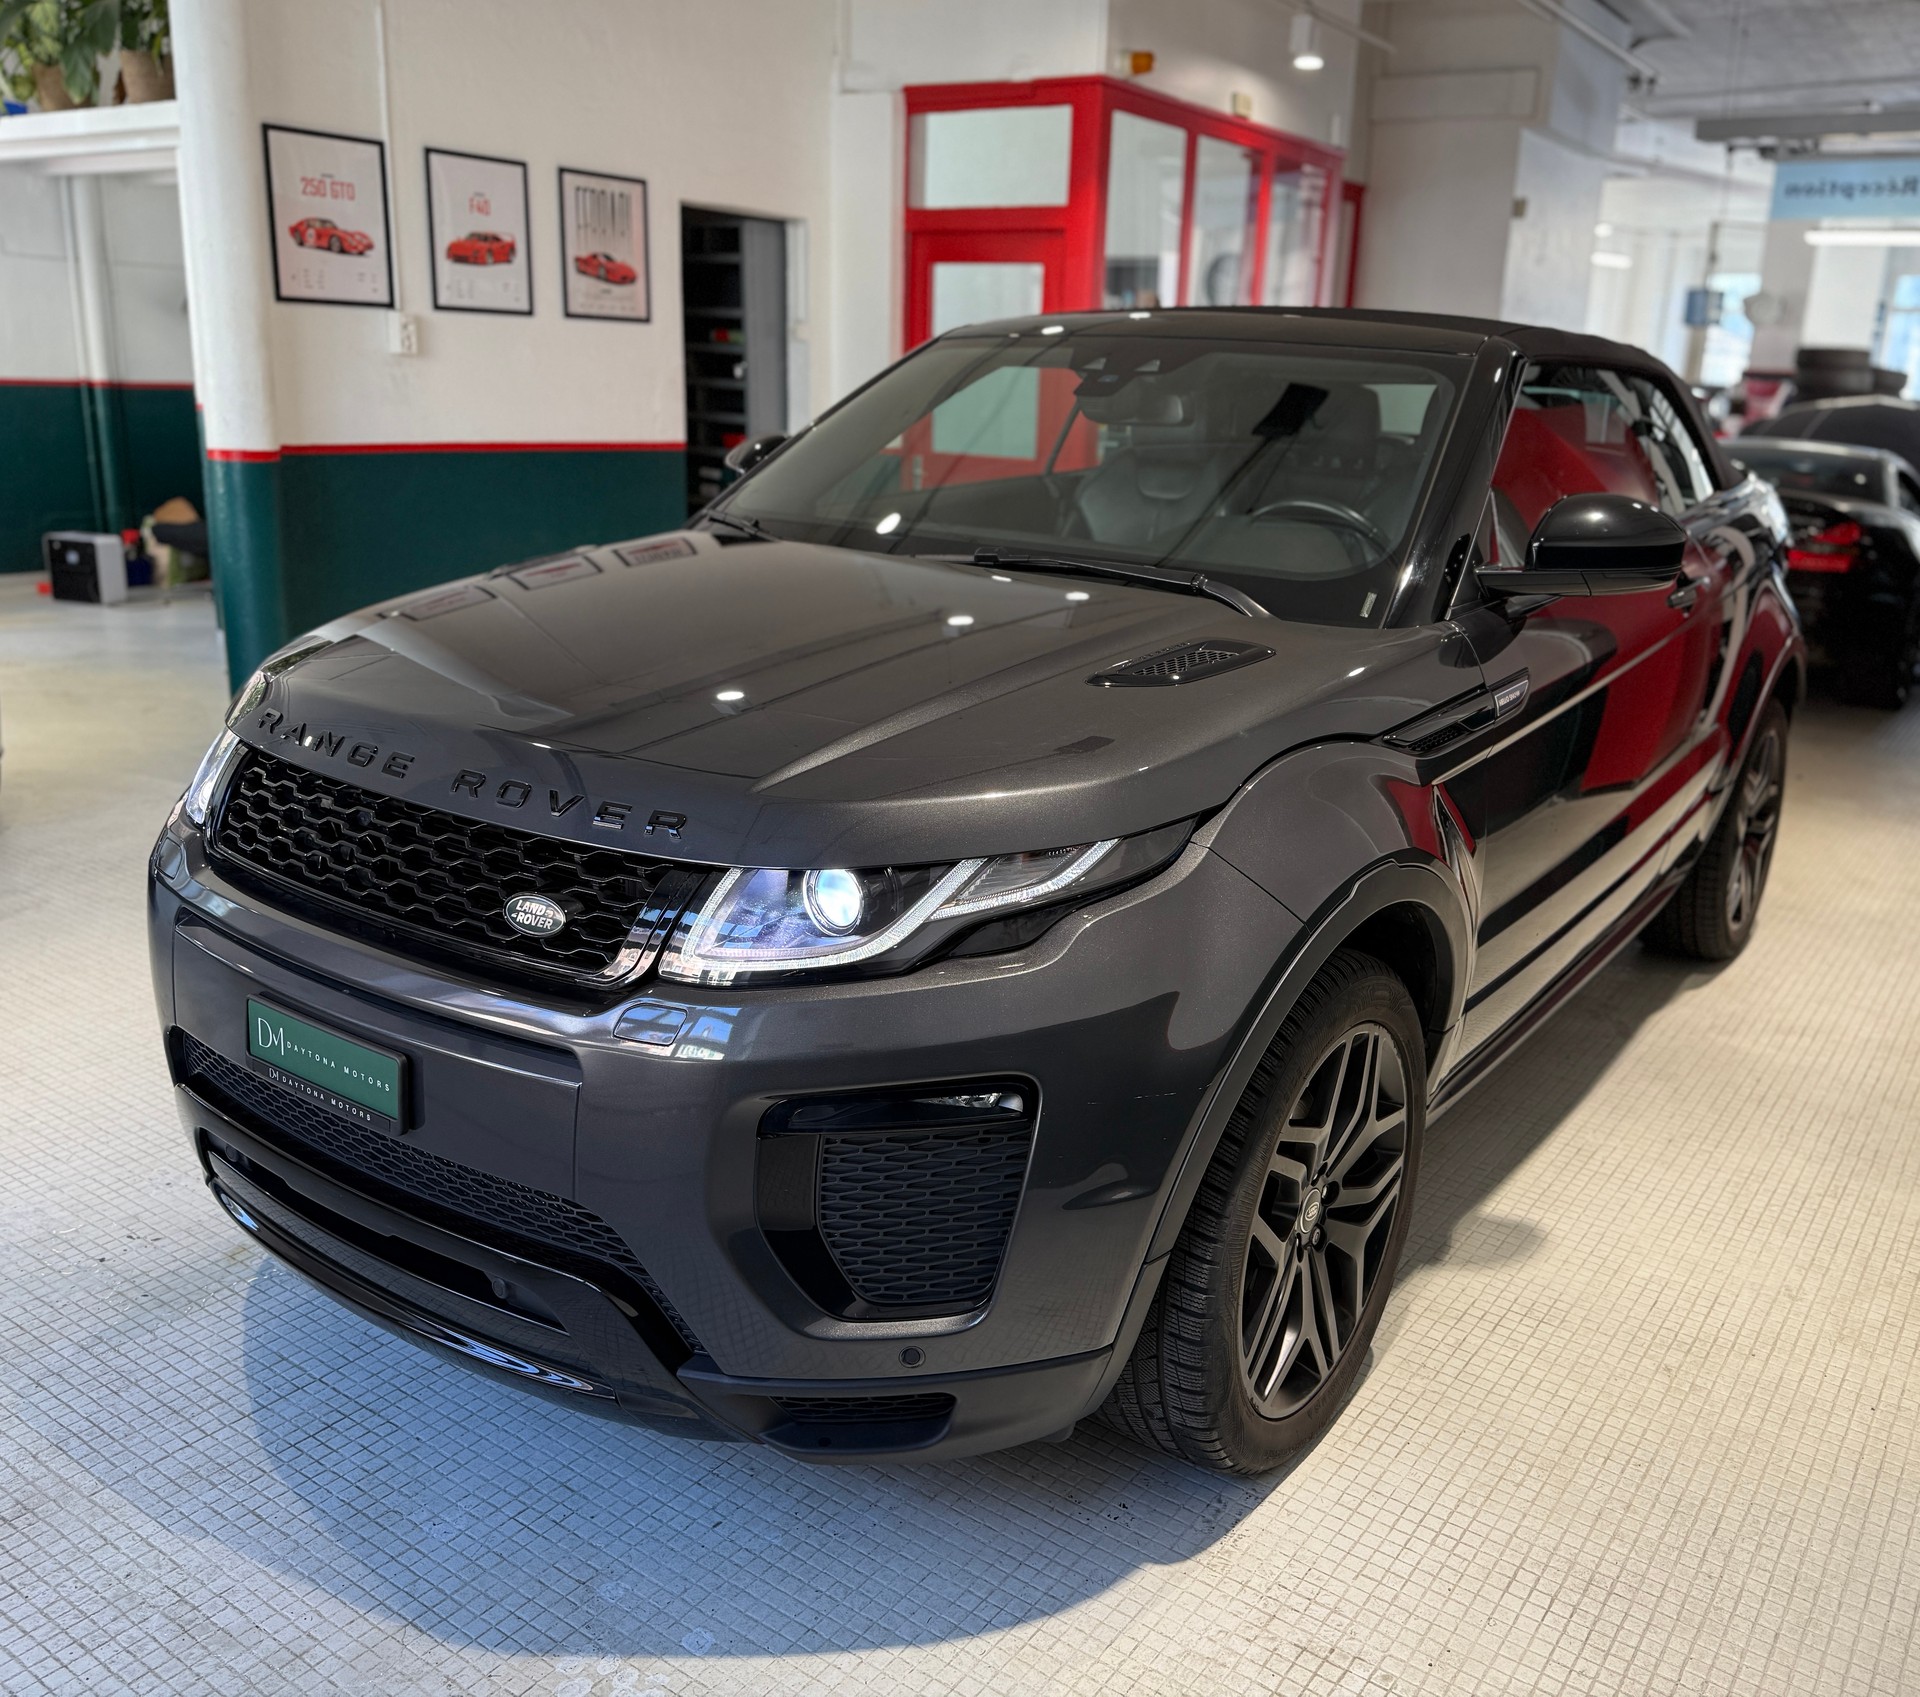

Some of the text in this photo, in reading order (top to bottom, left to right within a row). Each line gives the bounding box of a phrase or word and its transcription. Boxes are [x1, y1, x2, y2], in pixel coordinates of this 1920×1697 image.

[300, 176, 356, 202] 250 GTO
[257, 707, 688, 840] RANGE ROVER
[515, 899, 547, 916] LAND
[516, 911, 553, 930] ROVER
[257, 1017, 391, 1093] DM DAYTONA MOTORS
[282, 1076, 325, 1101] DAYTONA
[331, 1098, 371, 1122] MOTORS
